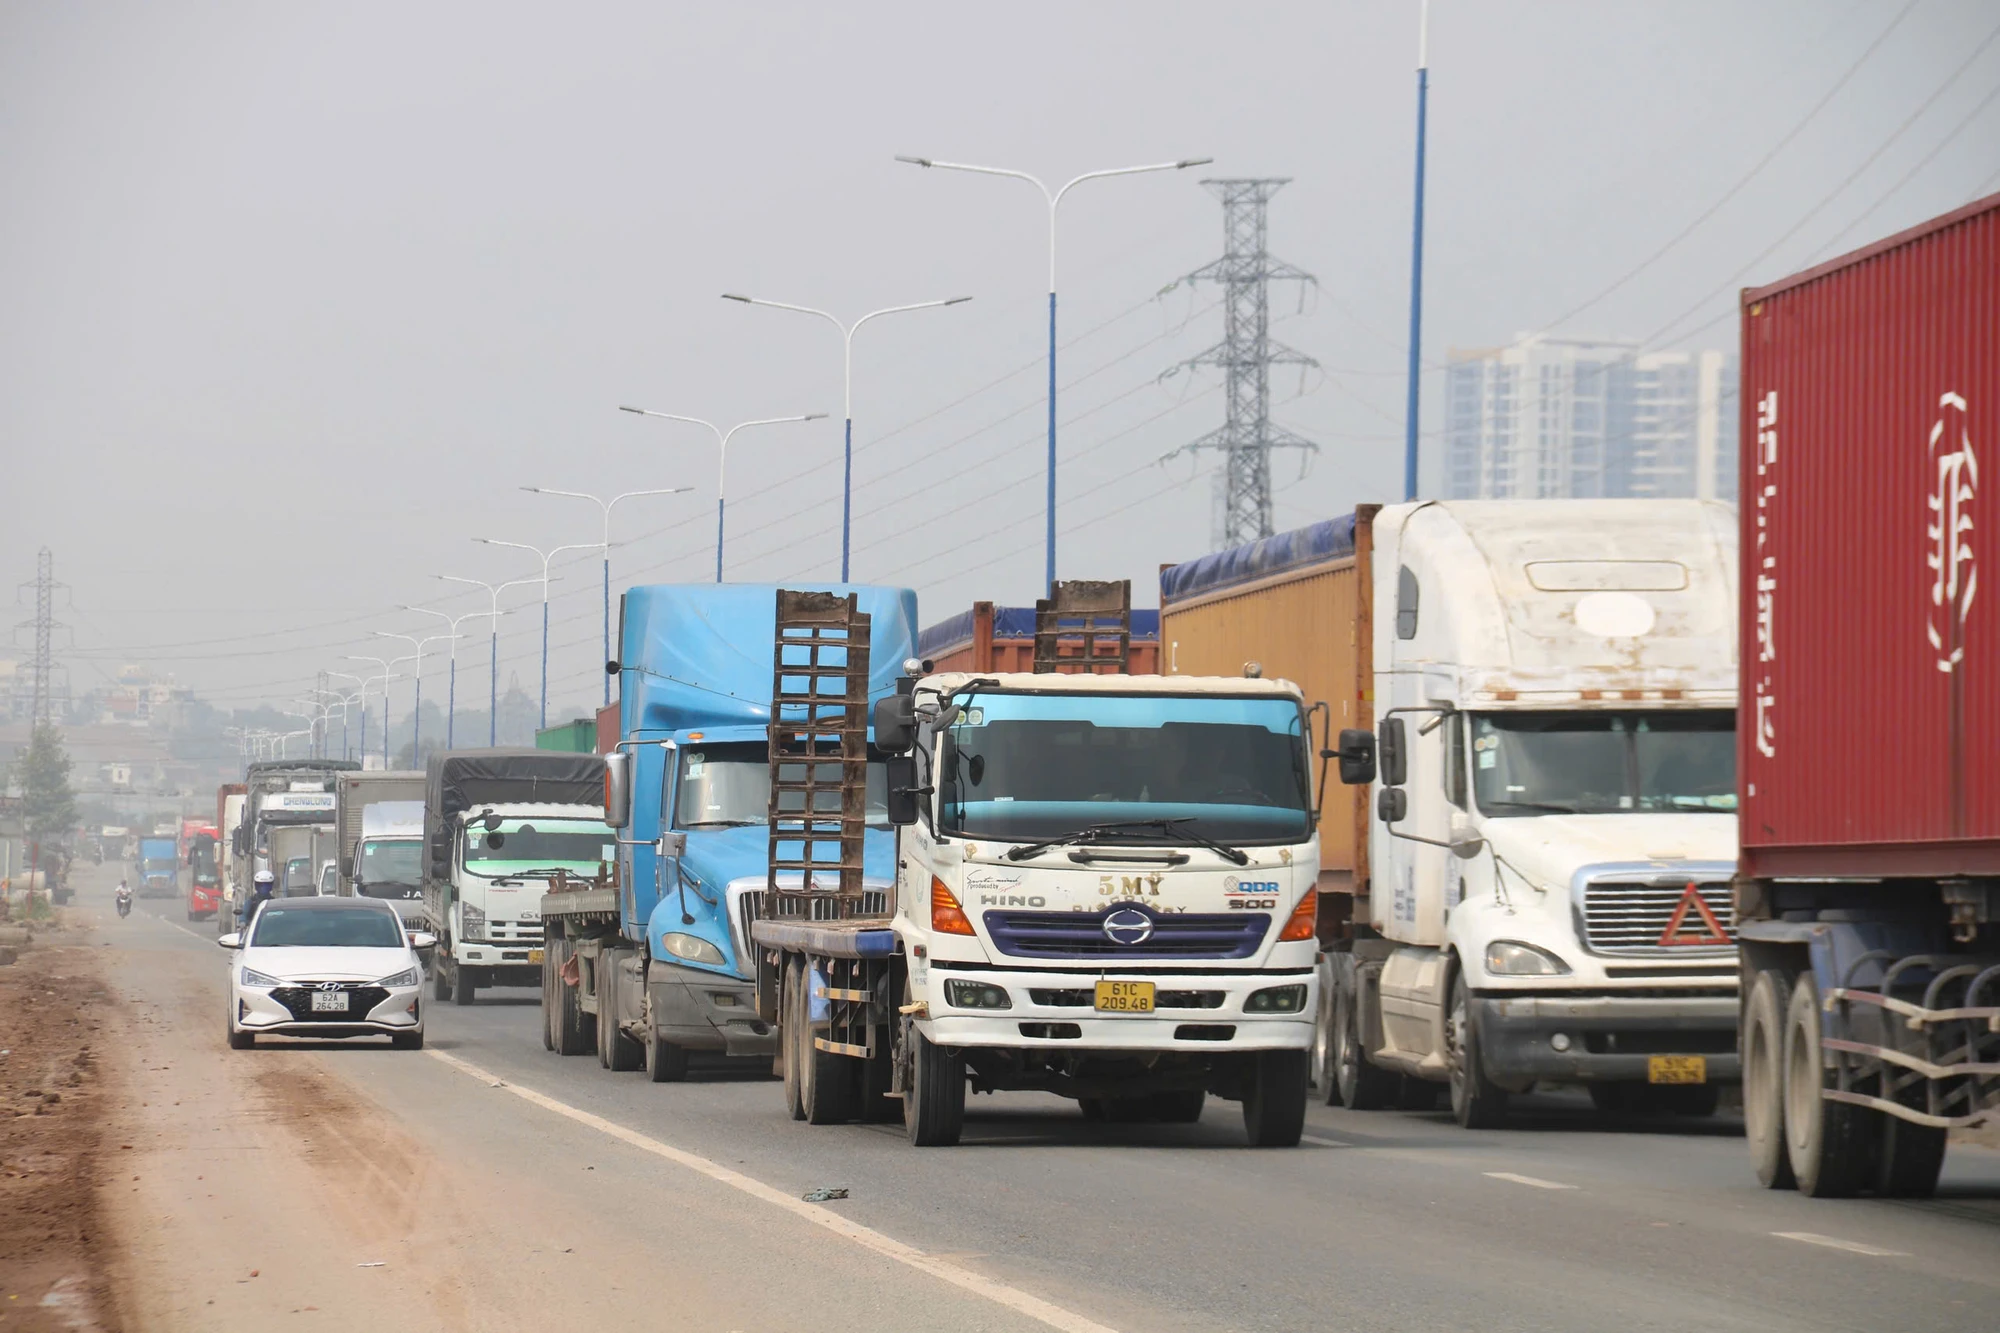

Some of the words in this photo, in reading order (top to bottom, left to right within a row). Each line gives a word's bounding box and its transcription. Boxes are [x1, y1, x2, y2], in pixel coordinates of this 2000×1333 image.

[1098, 875, 1115, 896] 5
[1238, 881, 1280, 893] QDR
[402, 890, 424, 899] JA
[980, 894, 1046, 908] HINO
[1228, 899, 1276, 909] 500
[520, 909, 542, 920] ISU
[1112, 982, 1139, 996] 61C
[322, 993, 339, 1002] 62A
[1101, 996, 1149, 1010] 209.48
[316, 1002, 345, 1010] 264.28
